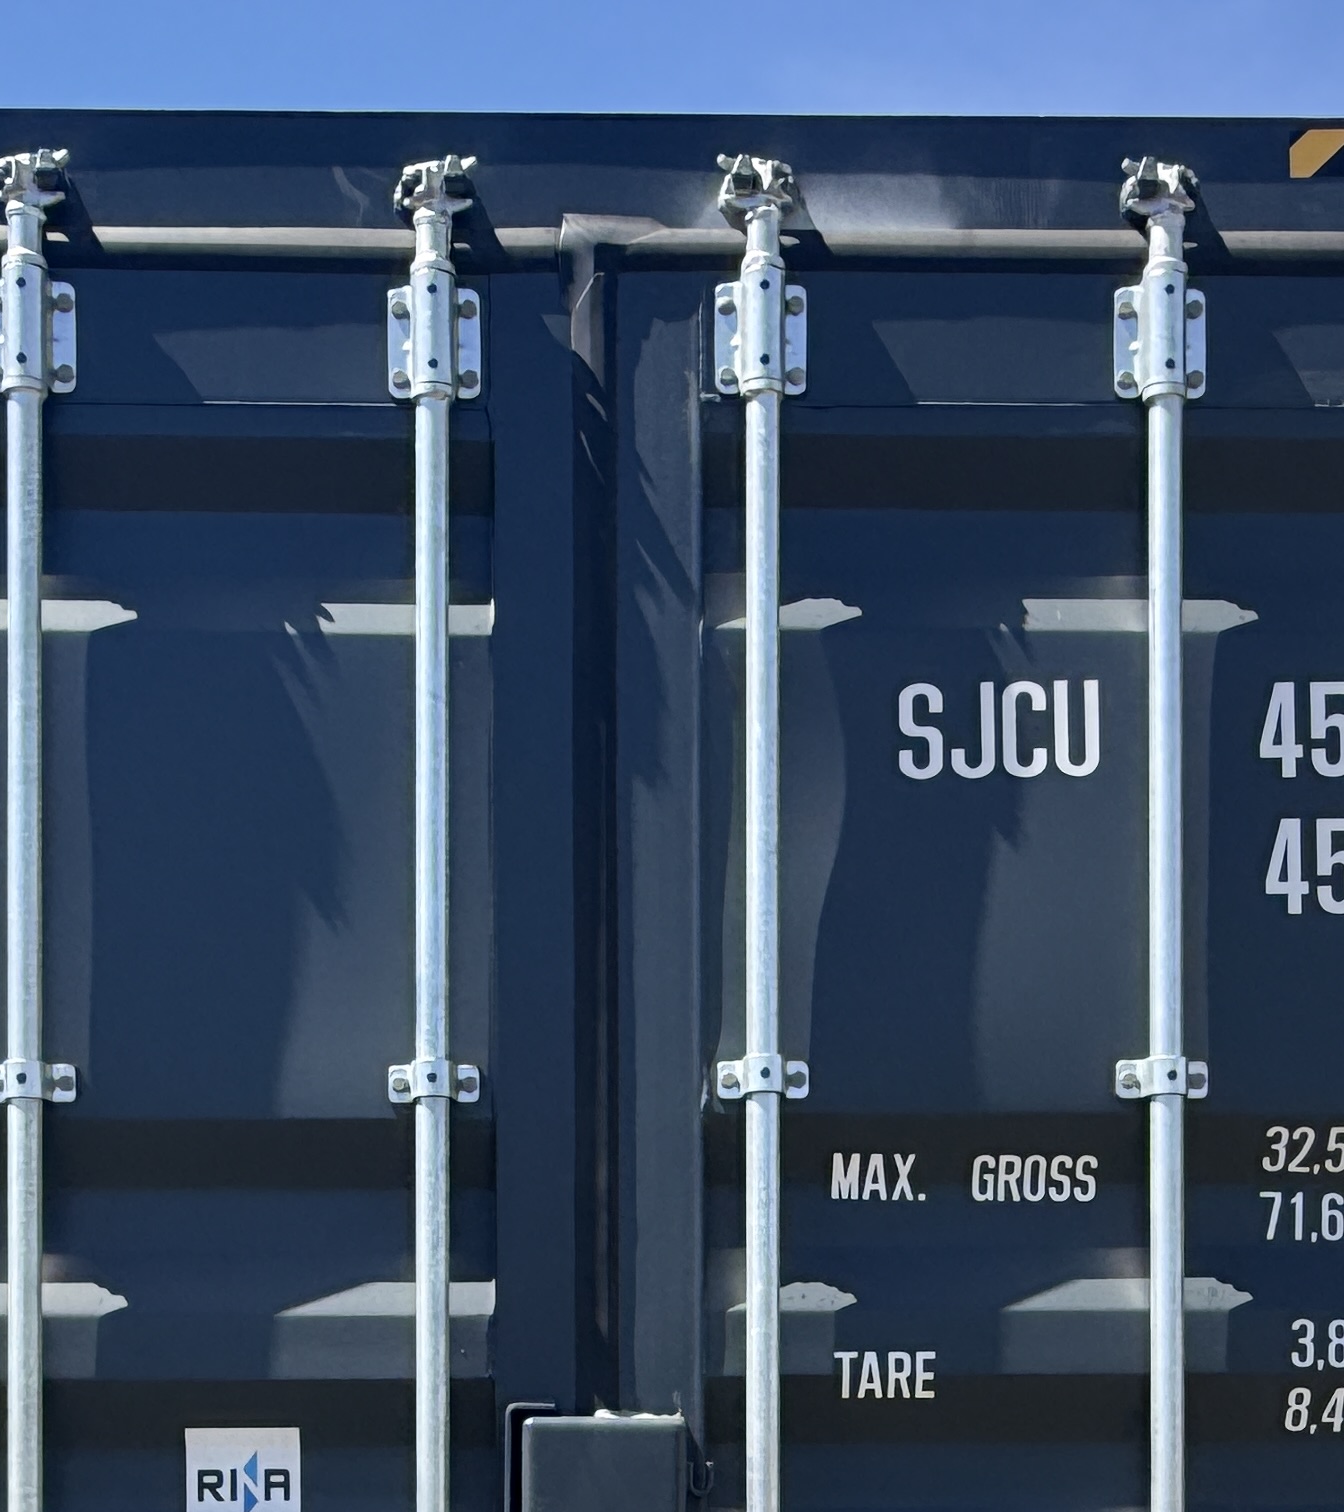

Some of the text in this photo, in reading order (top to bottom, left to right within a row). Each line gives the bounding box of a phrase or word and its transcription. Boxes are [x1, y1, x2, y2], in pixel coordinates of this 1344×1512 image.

[898, 679, 1100, 780] SJCU
[830, 1152, 1099, 1202] MAX. GROSS
[833, 1351, 936, 1399] TARE
